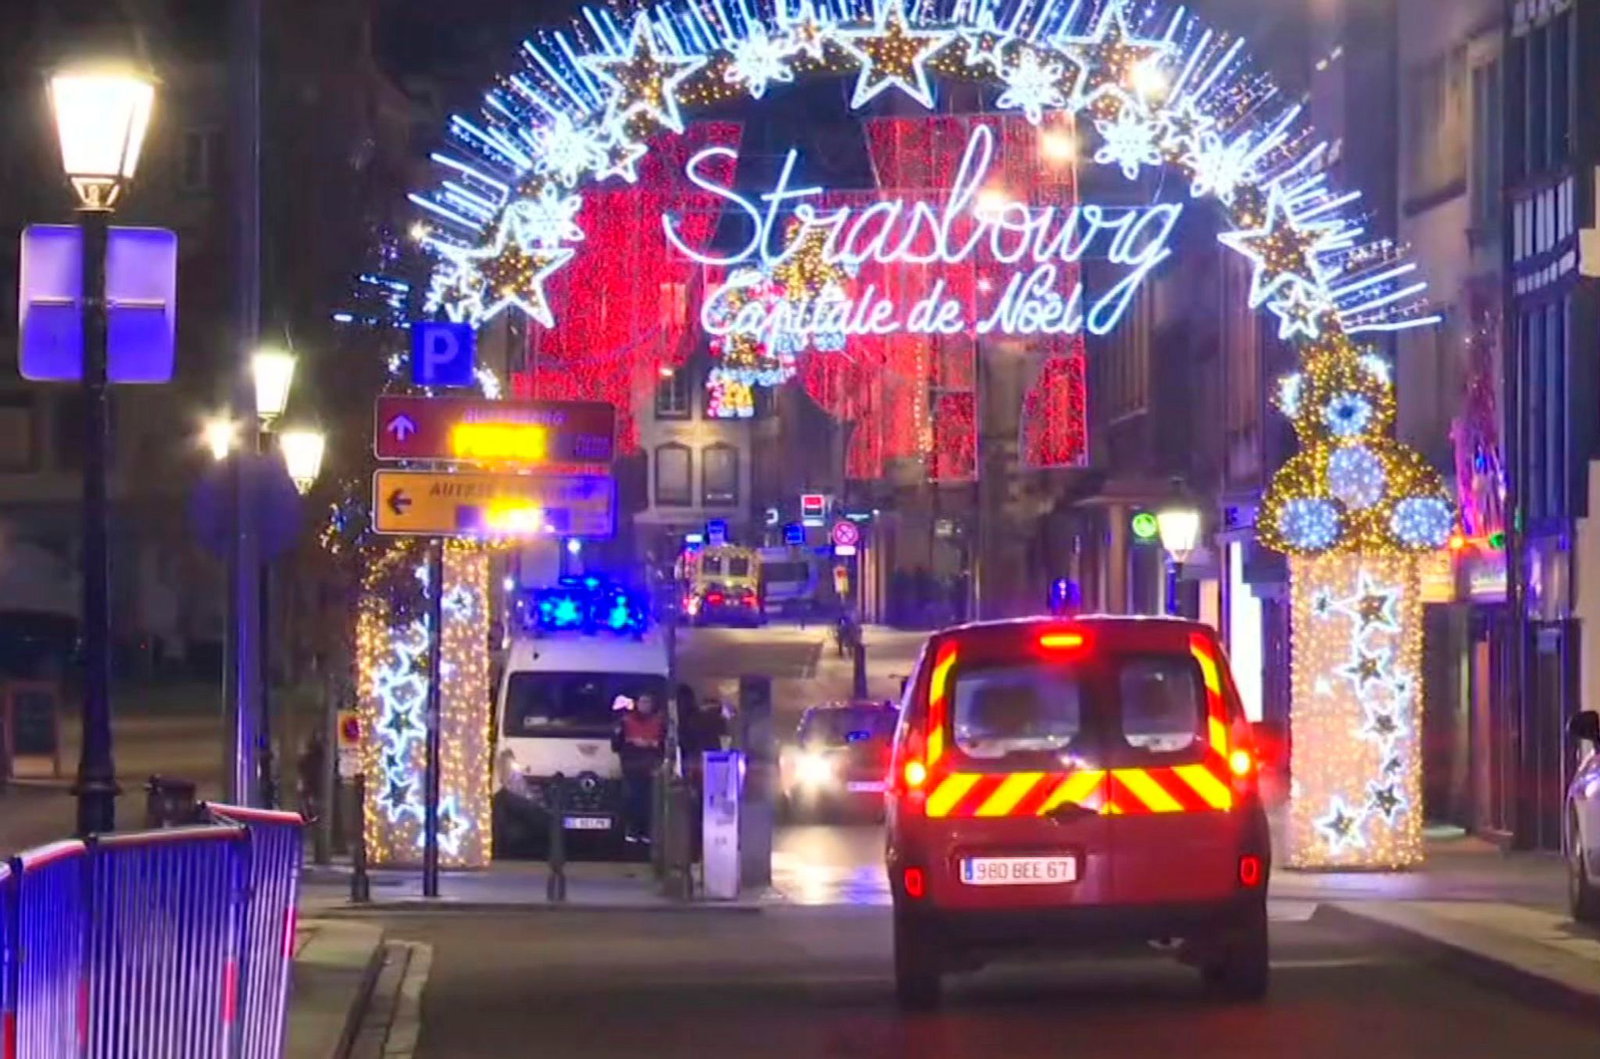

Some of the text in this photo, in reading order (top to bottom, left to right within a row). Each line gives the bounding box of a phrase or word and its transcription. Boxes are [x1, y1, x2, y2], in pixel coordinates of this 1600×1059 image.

[662, 124, 1183, 335] Strasbourg
[700, 263, 1083, 355] Capitale de Noël
[423, 328, 460, 380] P
[976, 860, 1068, 880] 980 BEE 67
